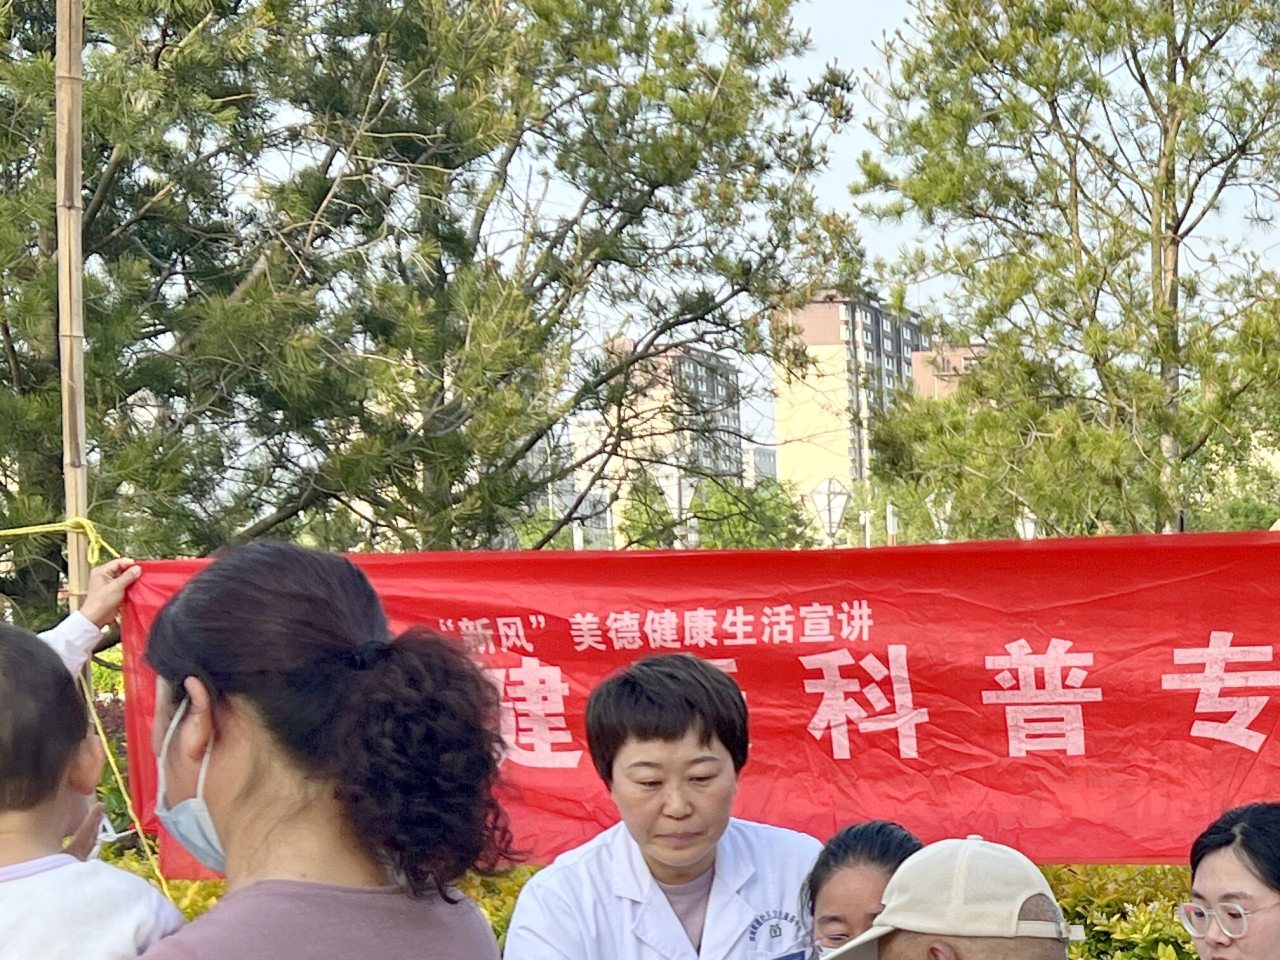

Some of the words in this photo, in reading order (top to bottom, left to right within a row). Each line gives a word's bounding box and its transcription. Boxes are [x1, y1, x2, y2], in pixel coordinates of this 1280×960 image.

[568, 601, 873, 652] 美德健康生活宣讲
